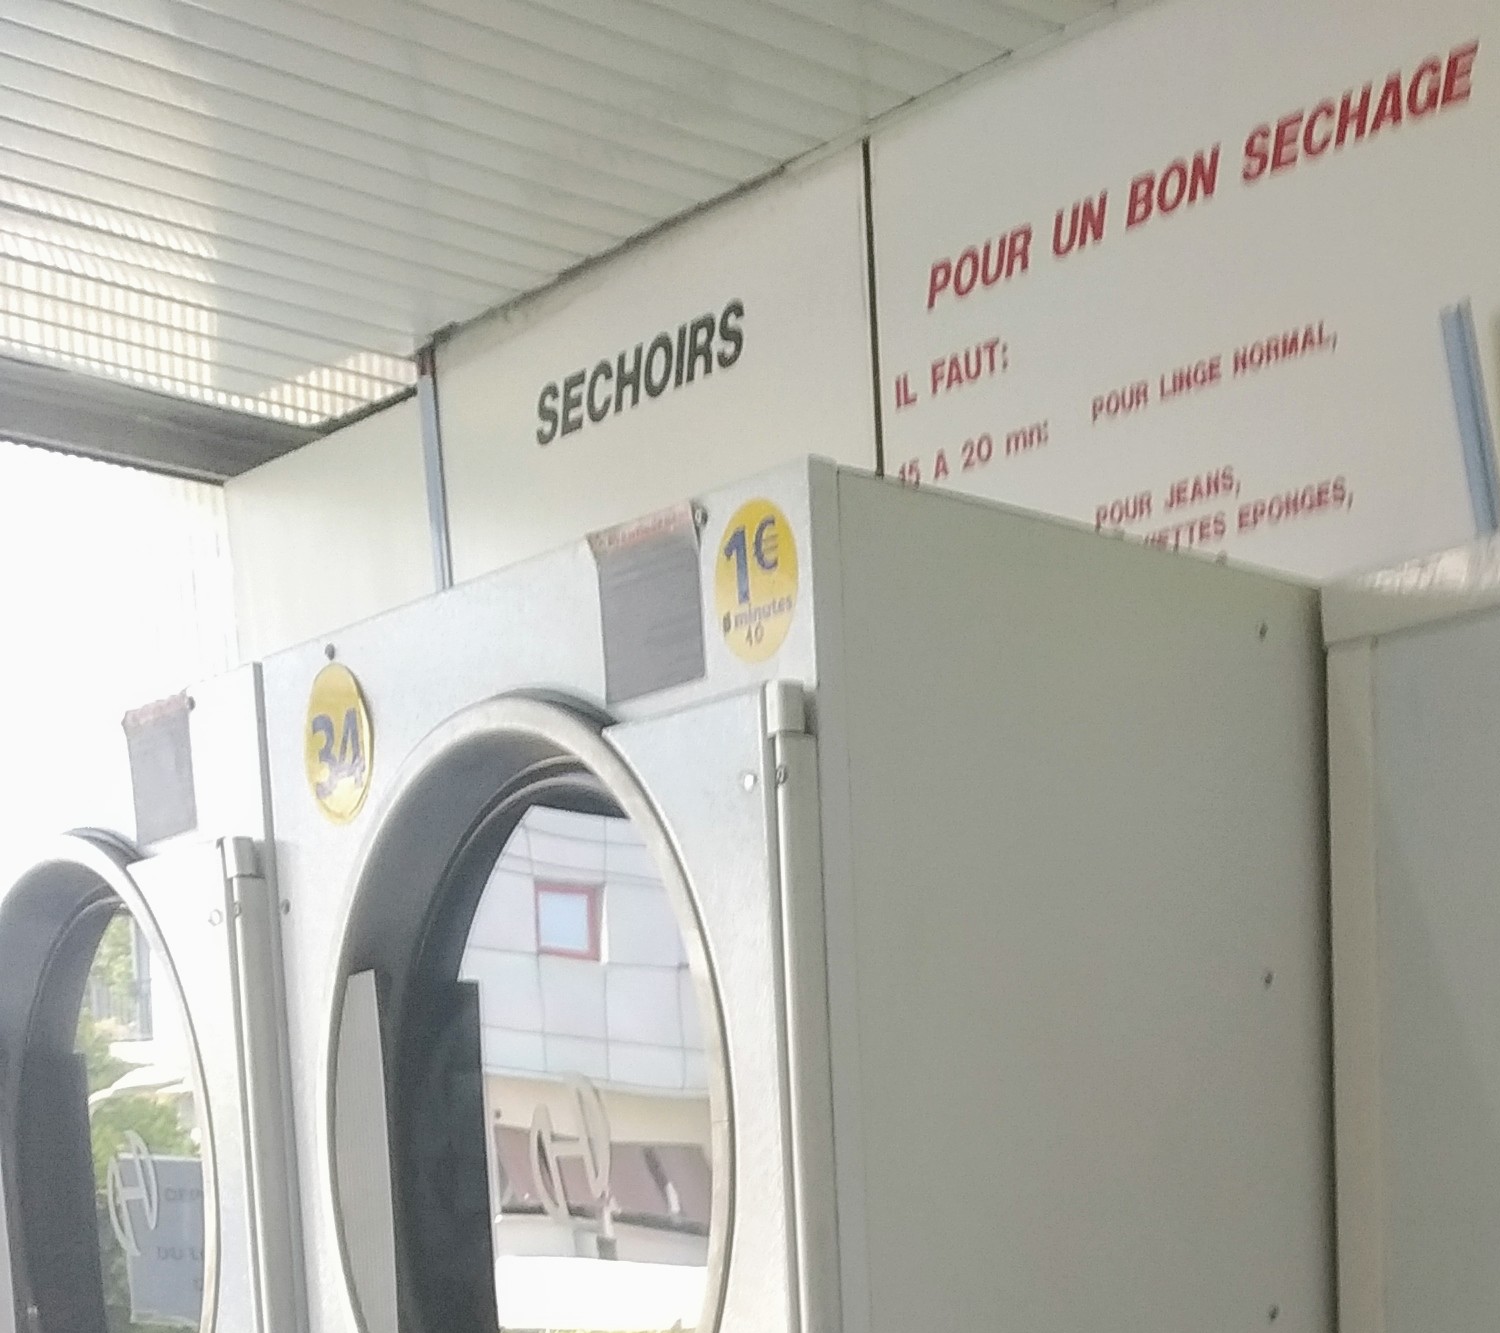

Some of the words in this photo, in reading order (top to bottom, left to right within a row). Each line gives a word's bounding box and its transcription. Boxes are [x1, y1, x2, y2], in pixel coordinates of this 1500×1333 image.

[926, 222, 1033, 311] POUR
[1051, 189, 1108, 258] UN
[1125, 143, 1222, 232] BON
[1241, 39, 1481, 184] SECHAGE
[536, 298, 746, 446] SECHOIRS
[894, 372, 918, 410] IL
[930, 337, 1009, 396] FAUT:
[1091, 378, 1149, 422] POUR
[1159, 353, 1222, 399] LINGE
[1232, 319, 1339, 373] NORMAL,
[934, 447, 949, 481] A
[961, 431, 994, 471] 20
[1094, 489, 1152, 533] POUR
[1164, 464, 1241, 512] JEANS,
[723, 514, 779, 605] 1€
[311, 707, 366, 800] 34
